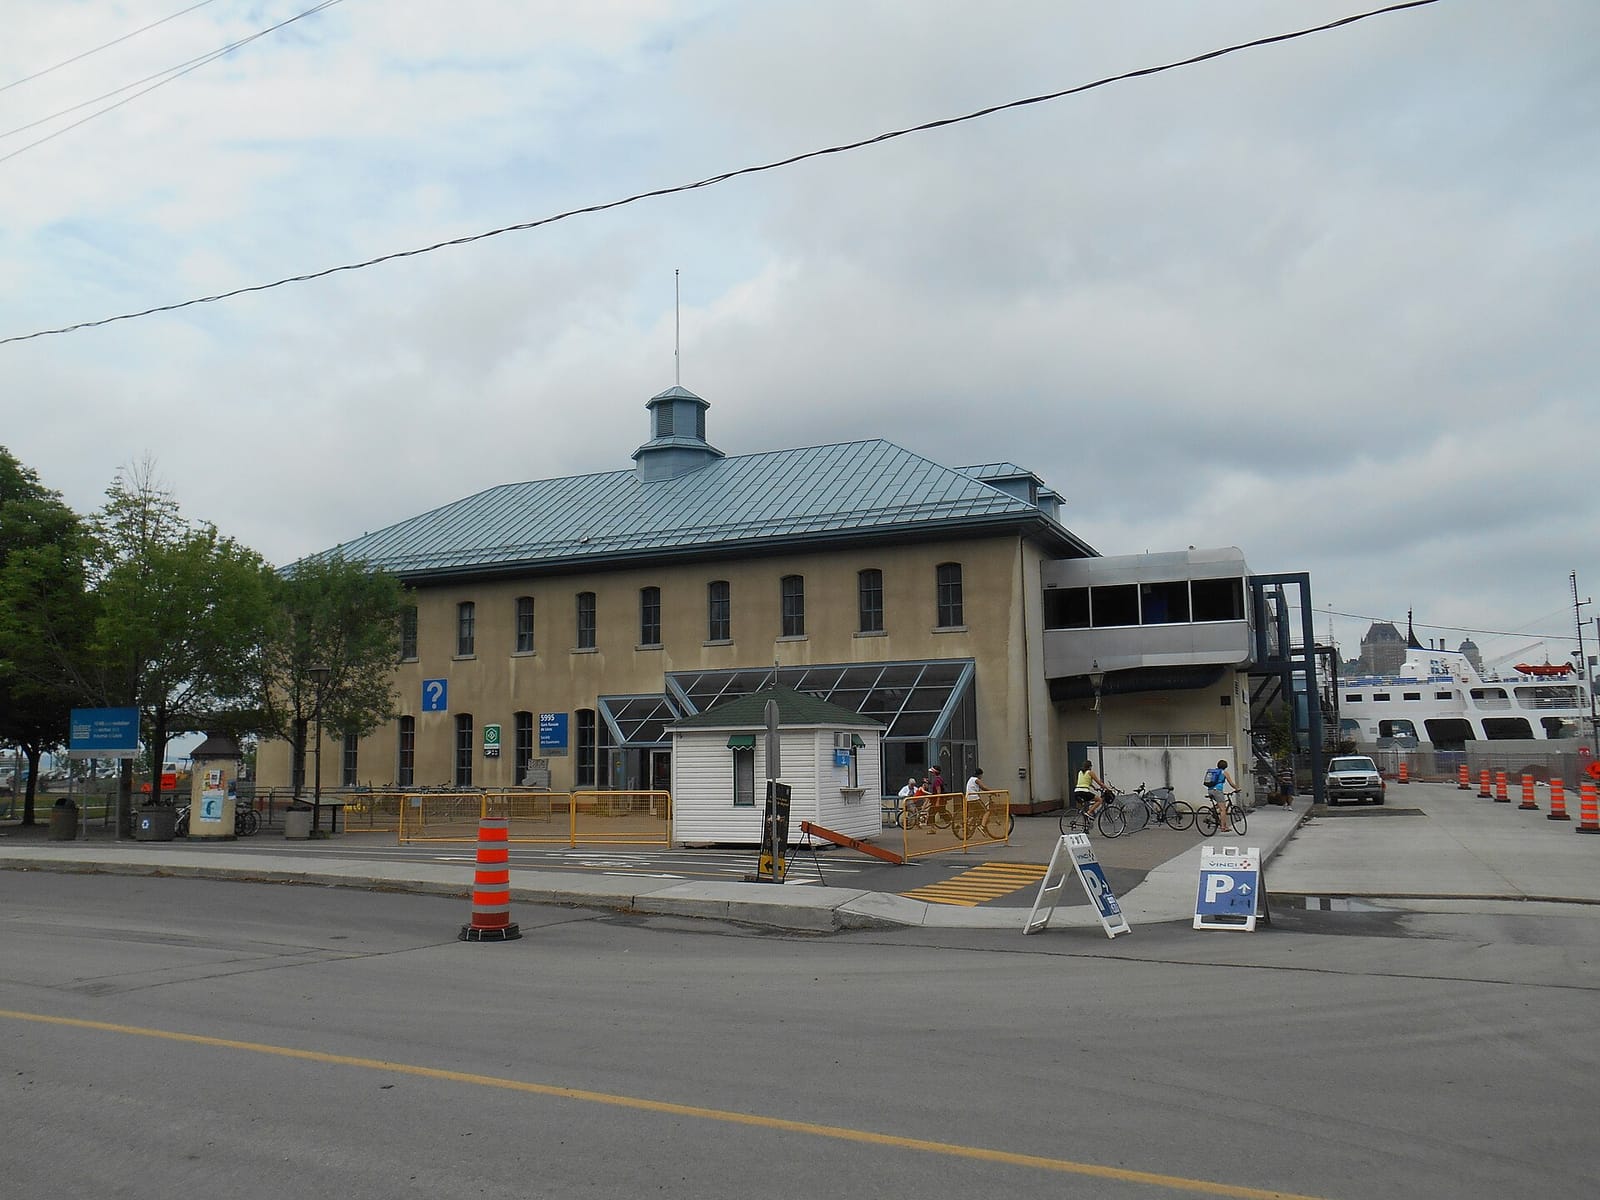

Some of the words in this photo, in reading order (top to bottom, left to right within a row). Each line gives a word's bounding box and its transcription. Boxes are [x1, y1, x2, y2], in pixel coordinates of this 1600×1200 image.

[427, 681, 443, 709] ?
[1082, 869, 1105, 911] P
[1205, 874, 1235, 903] P
